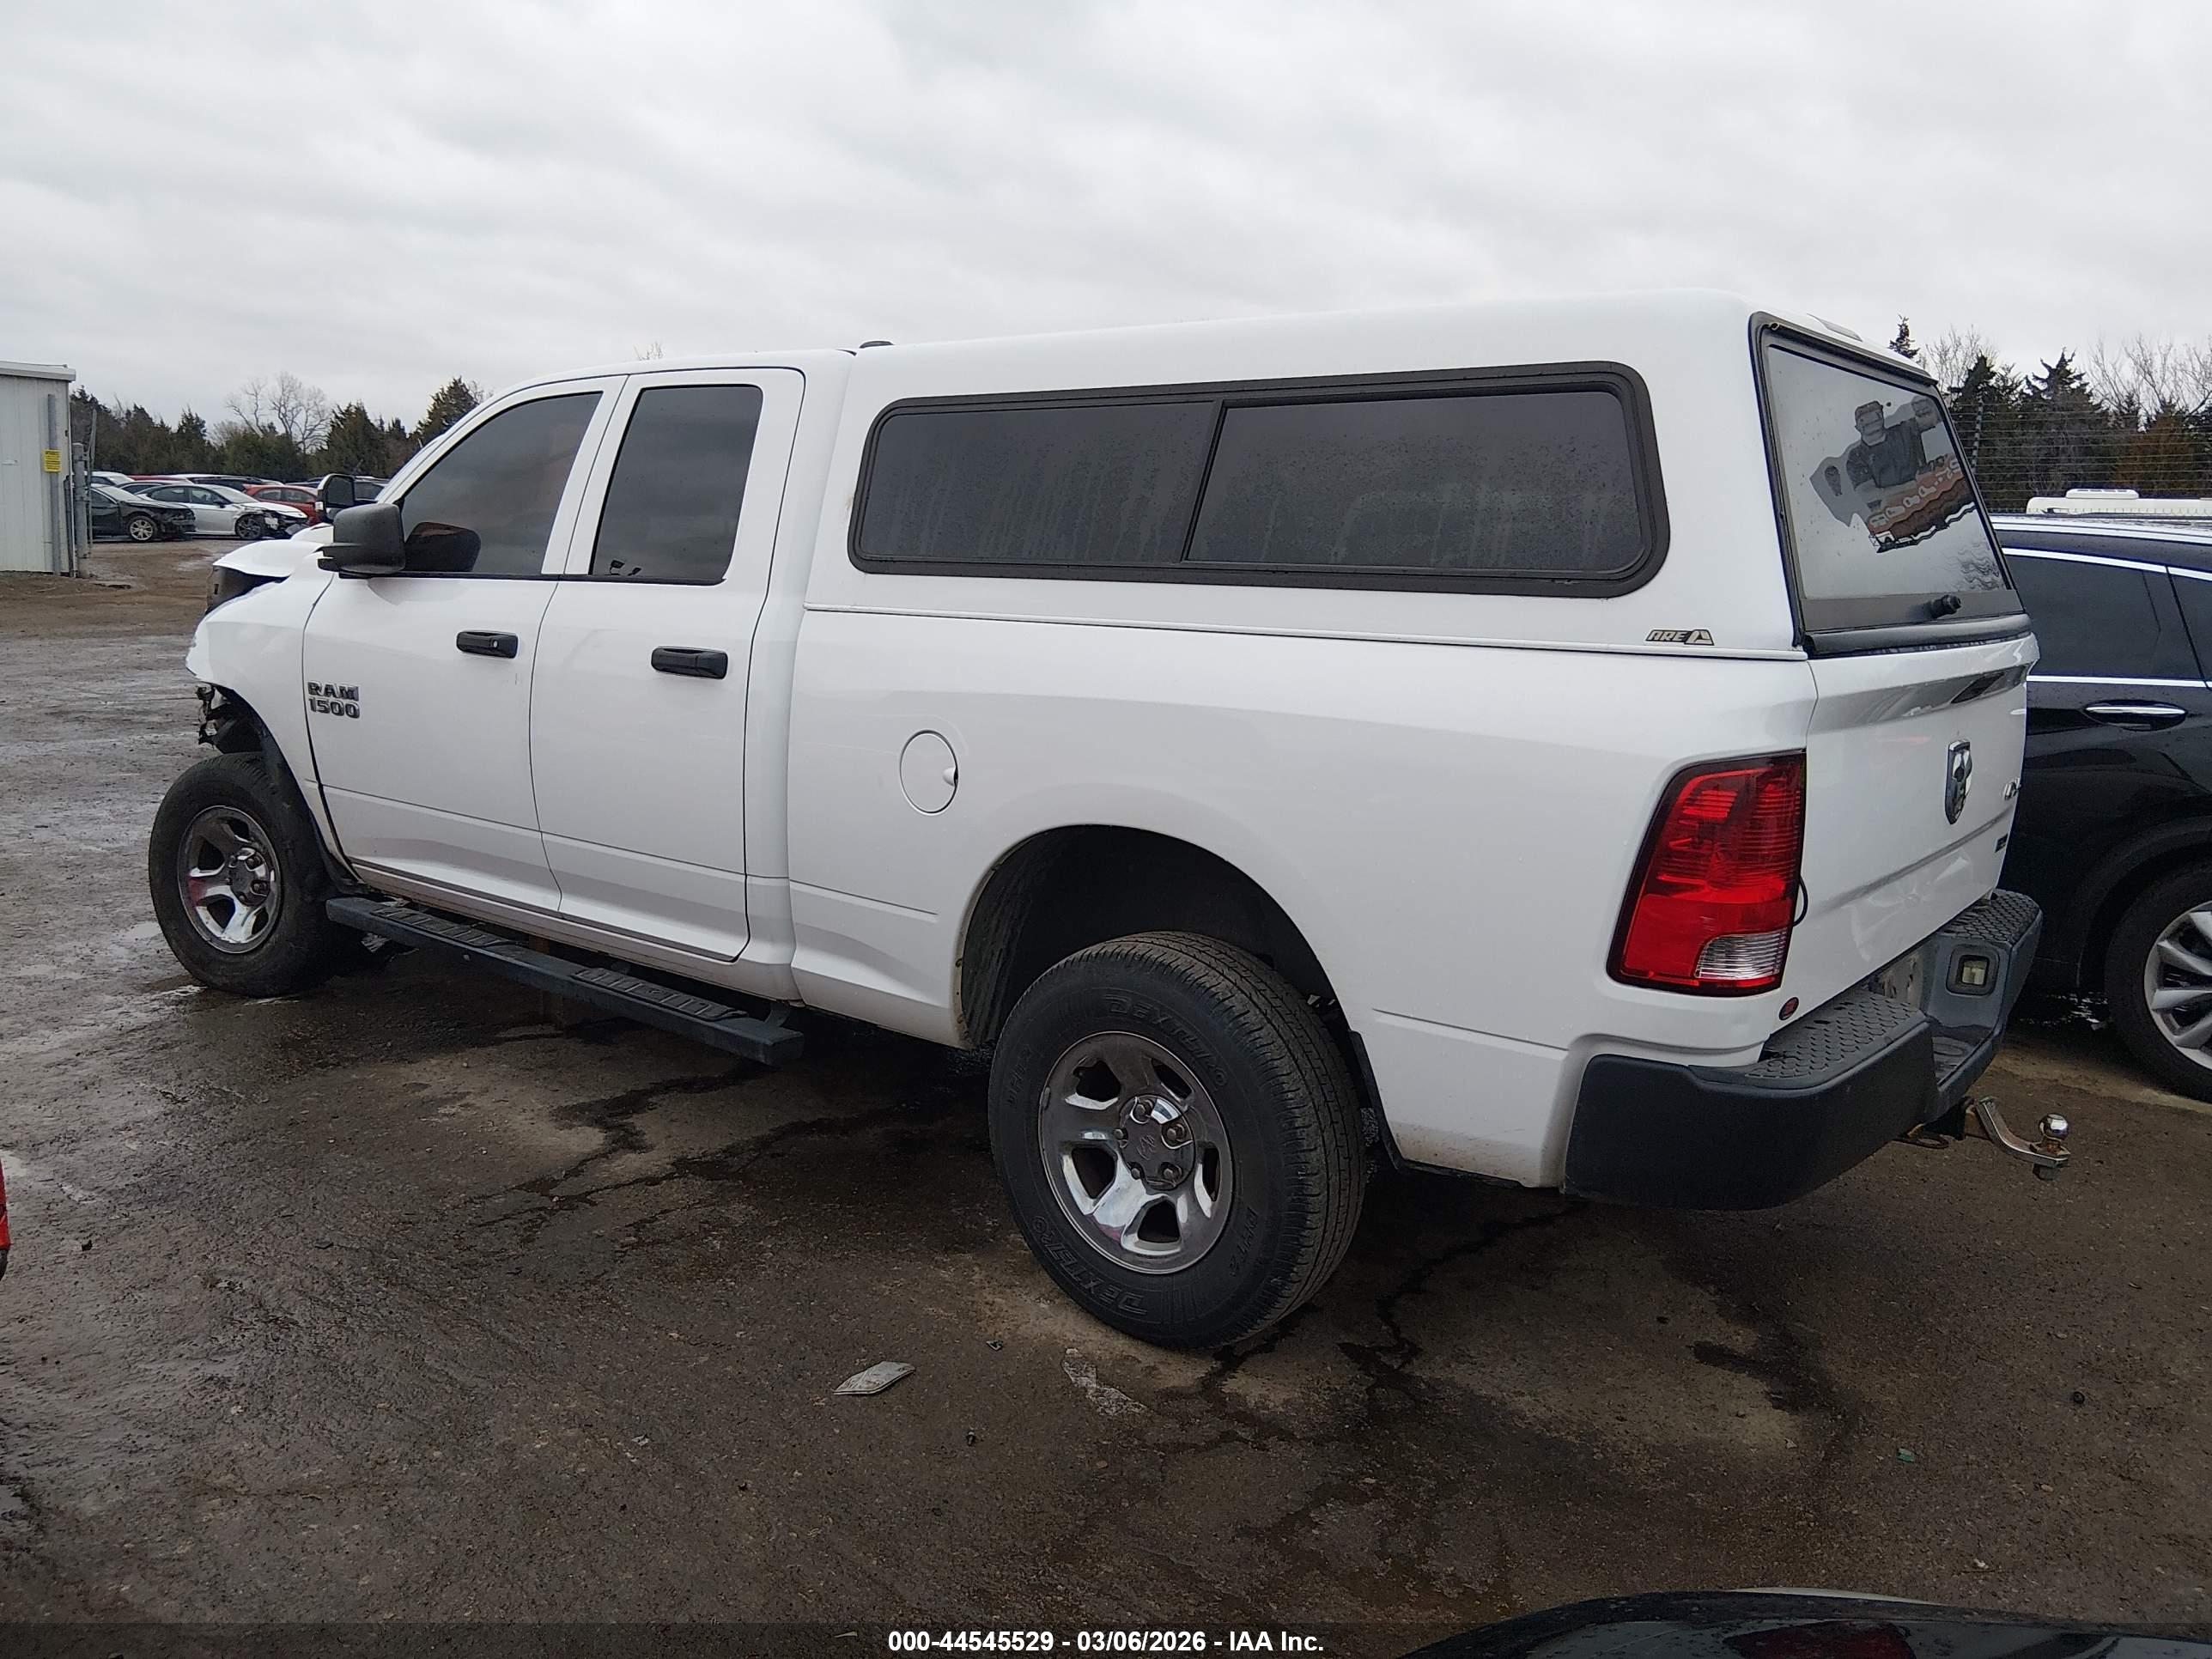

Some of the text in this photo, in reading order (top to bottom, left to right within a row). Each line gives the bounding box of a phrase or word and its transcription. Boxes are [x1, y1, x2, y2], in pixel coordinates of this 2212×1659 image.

[307, 681, 359, 701] RAM
[308, 696, 360, 719] 1500
[1031, 1215, 1147, 1316] DEXTERO
